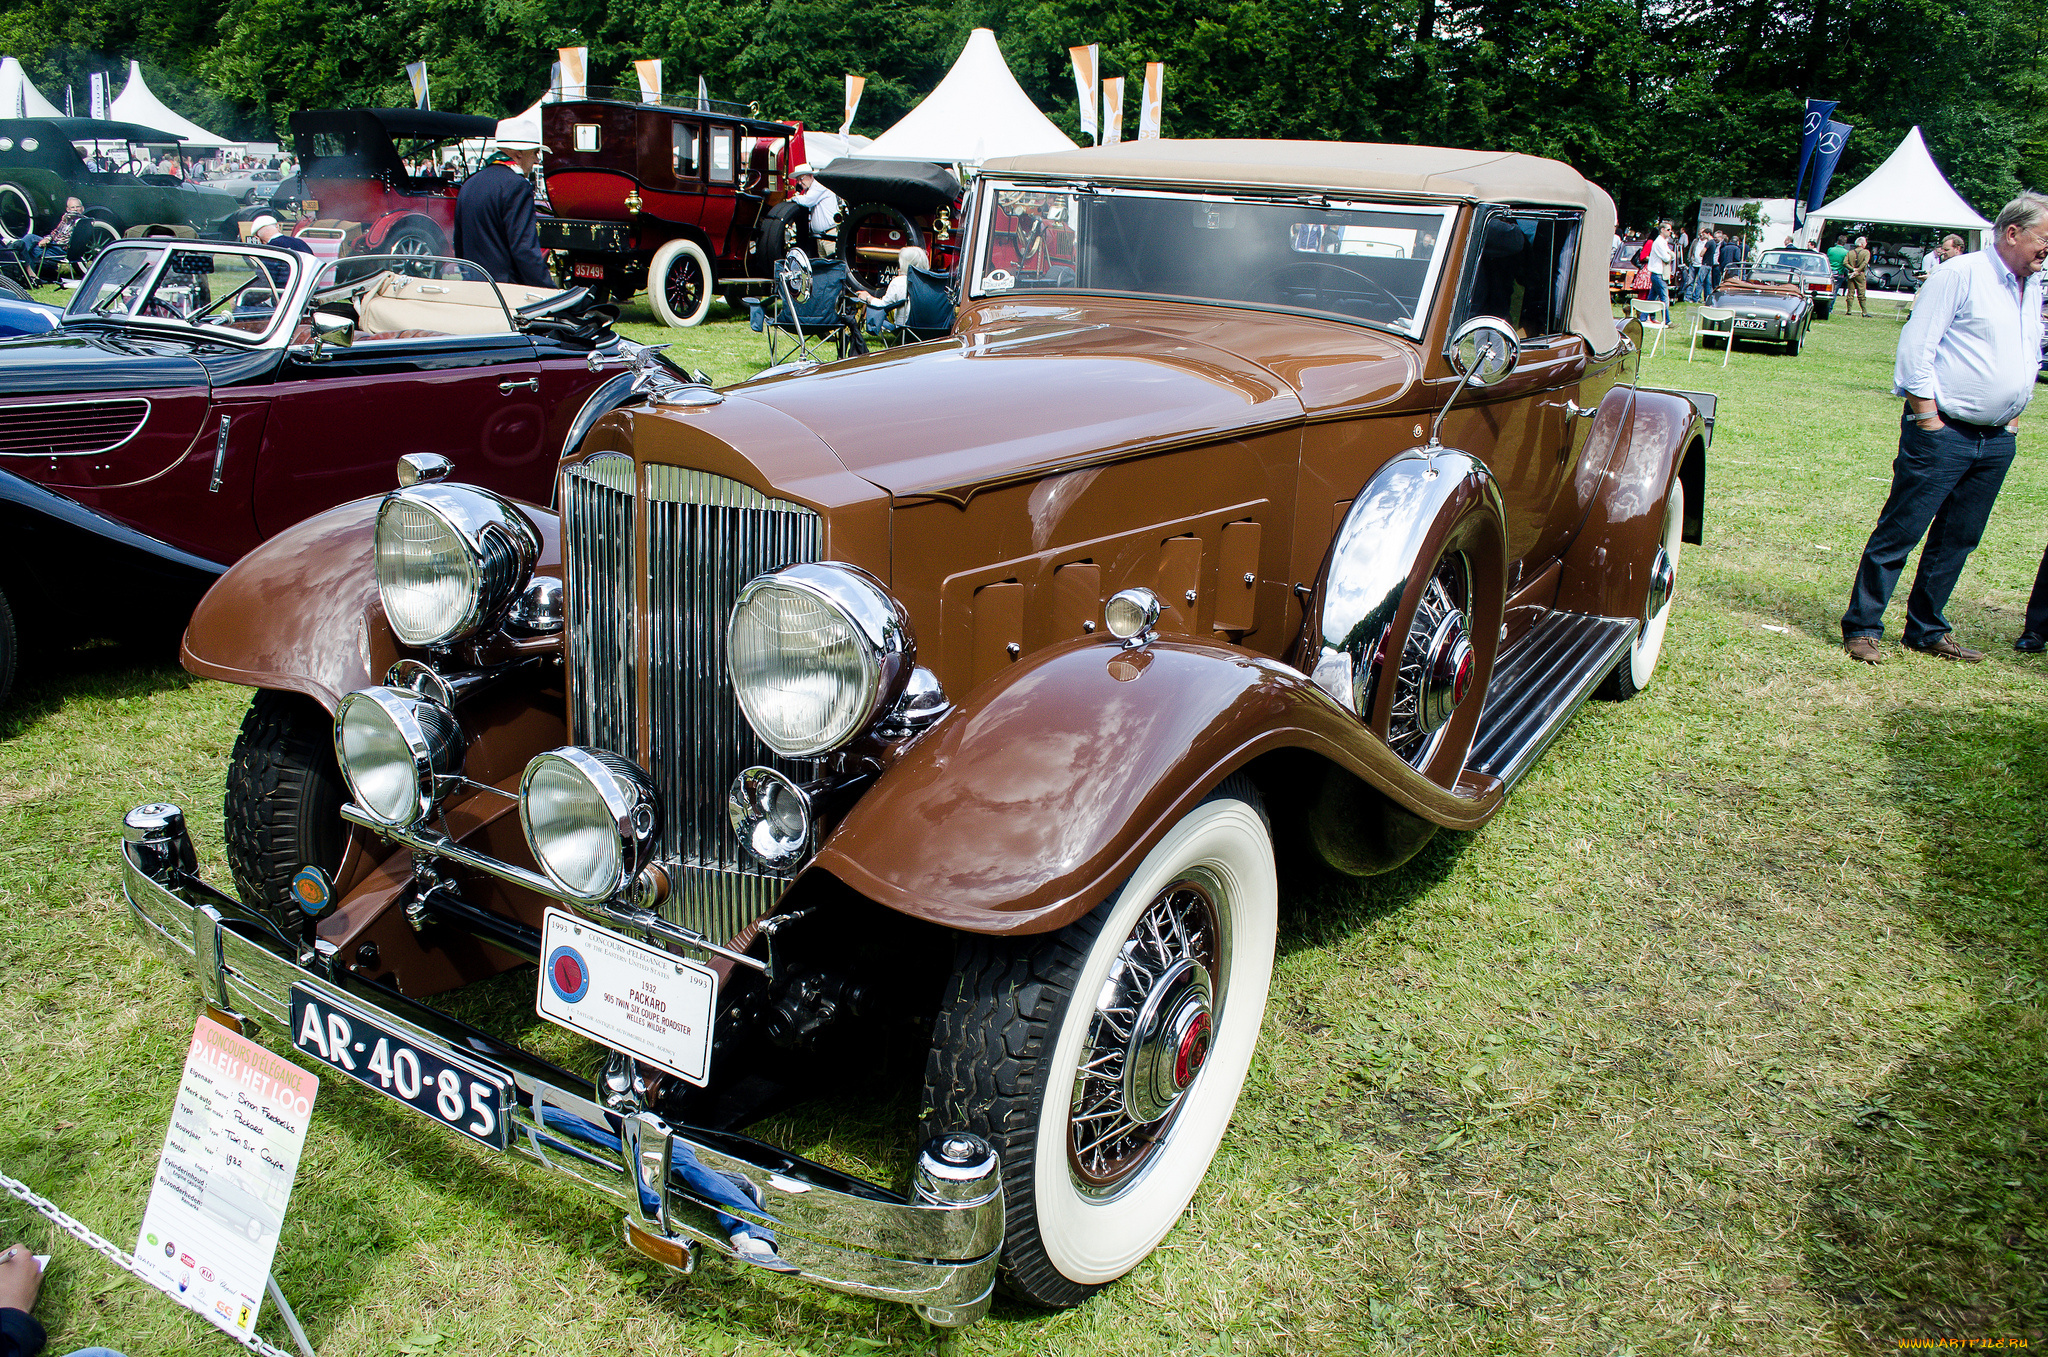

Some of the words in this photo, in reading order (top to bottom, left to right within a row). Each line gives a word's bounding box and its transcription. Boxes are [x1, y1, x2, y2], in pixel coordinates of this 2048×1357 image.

[575, 264, 600, 277] 35749
[884, 265, 899, 275] AM
[1734, 319, 1766, 329] AR-16-75
[551, 921, 568, 933] 1993
[588, 933, 626, 954] CONCOURS
[641, 980, 657, 994] 1932
[689, 975, 708, 989] 1993
[629, 988, 667, 1013] PACKARD
[603, 992, 614, 1004] 905
[615, 997, 630, 1011] TWIN
[630, 1003, 640, 1015] SIX
[641, 1008, 660, 1023] COUPE
[661, 1016, 692, 1036] ROADSTER
[626, 1012, 645, 1027] WELLES
[646, 1020, 667, 1035] WILDER
[206, 1028, 251, 1063] CONCOURS
[251, 1052, 304, 1092] D'ÉLÉGANCE
[298, 1002, 497, 1137] AR-40-85
[189, 1067, 213, 1085] Eigenaar
[191, 1038, 240, 1079] PALEIS
[240, 1065, 271, 1096] HET
[270, 1082, 310, 1118] LOO
[184, 1085, 198, 1098] Merk
[199, 1095, 212, 1106] auto
[180, 1102, 194, 1116] Type
[174, 1121, 201, 1141] Bouwjaar
[169, 1140, 187, 1154] Motor
[164, 1157, 205, 1186] Cylinderinhoud
